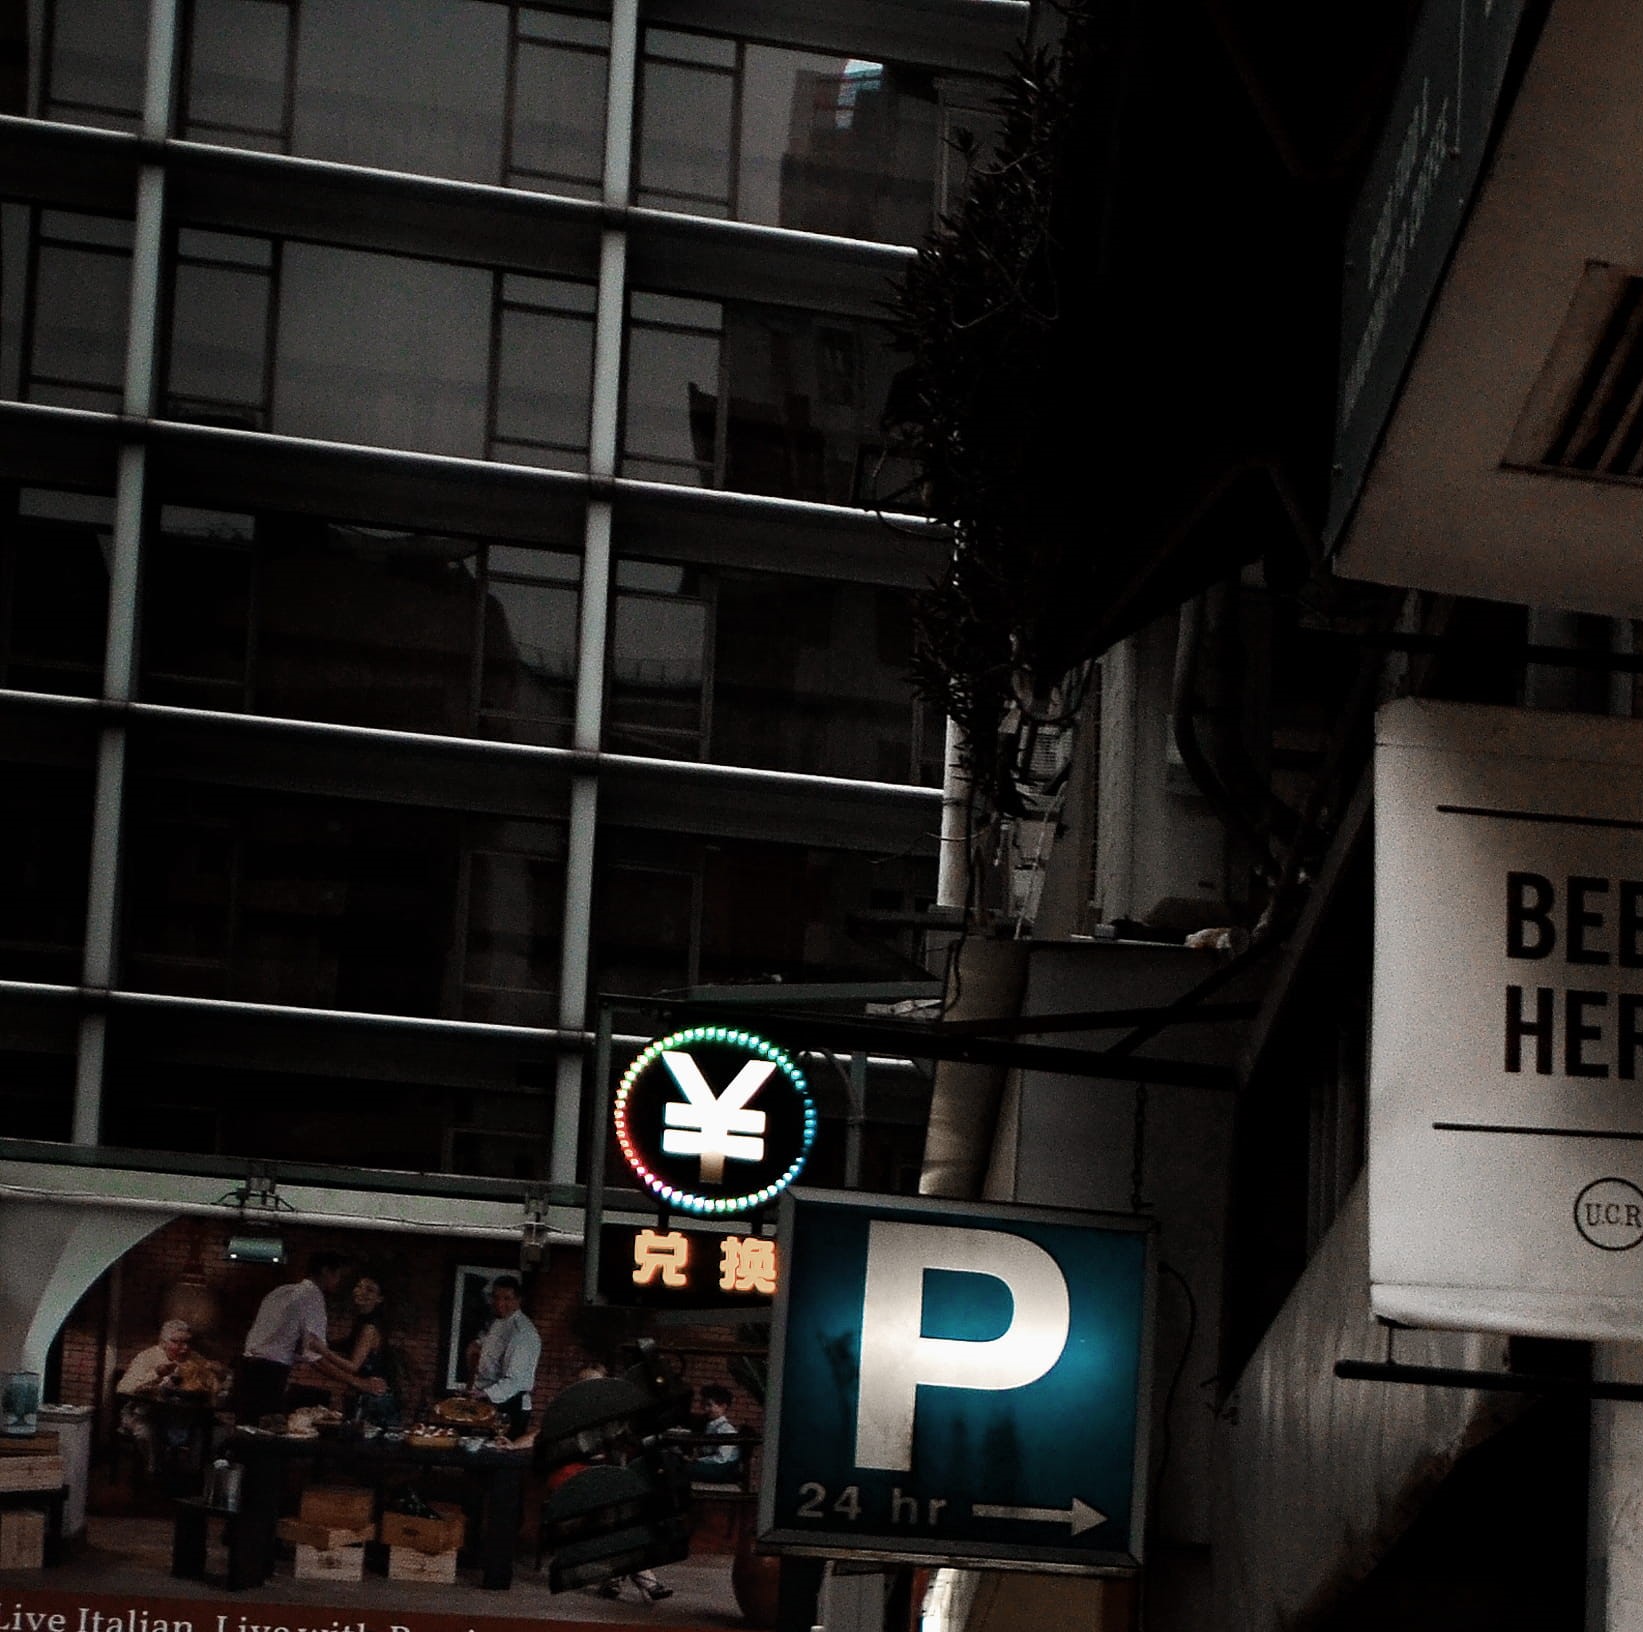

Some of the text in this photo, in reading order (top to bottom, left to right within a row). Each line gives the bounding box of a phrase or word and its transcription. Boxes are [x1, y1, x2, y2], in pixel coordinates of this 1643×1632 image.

[853, 1218, 1072, 1473] P
[795, 1480, 949, 1528] 24 hr
